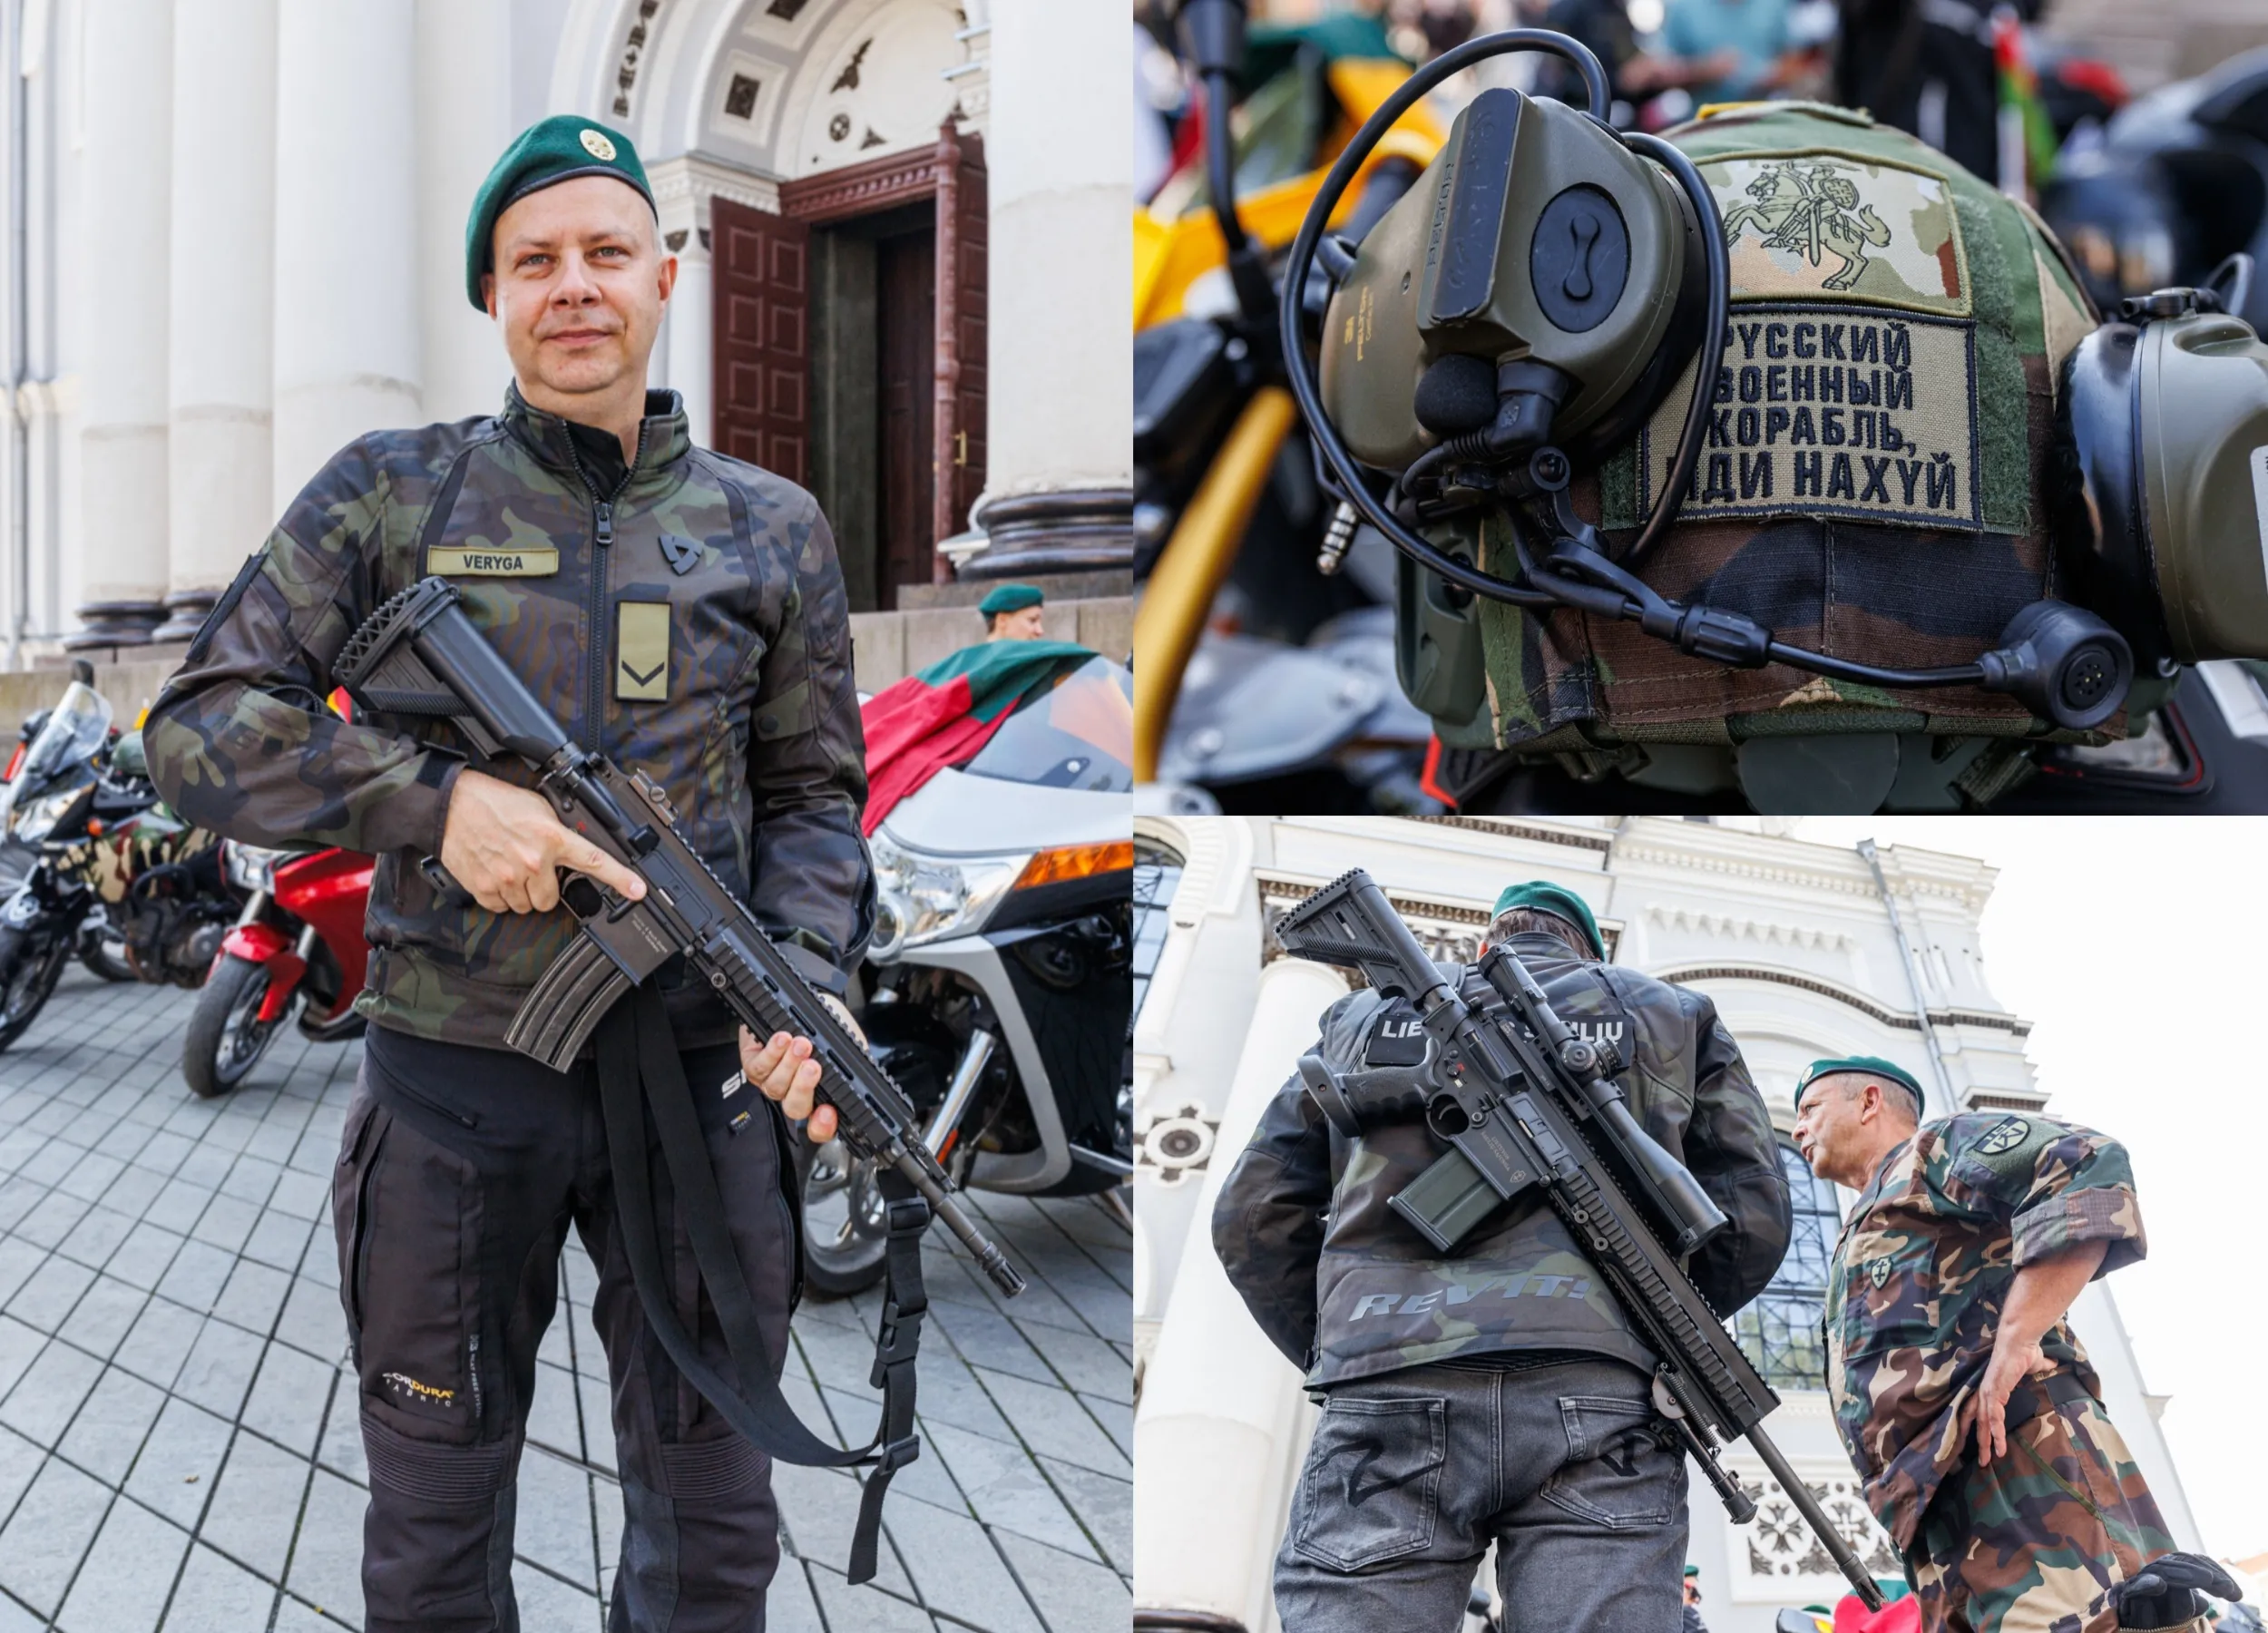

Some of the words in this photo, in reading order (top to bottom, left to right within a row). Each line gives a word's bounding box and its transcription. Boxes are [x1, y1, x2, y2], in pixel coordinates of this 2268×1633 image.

[1709, 406, 1916, 455] КОРАБЛЬ,
[1794, 451, 1956, 510] НАХУЙ
[463, 554, 523, 571] VERYGA
